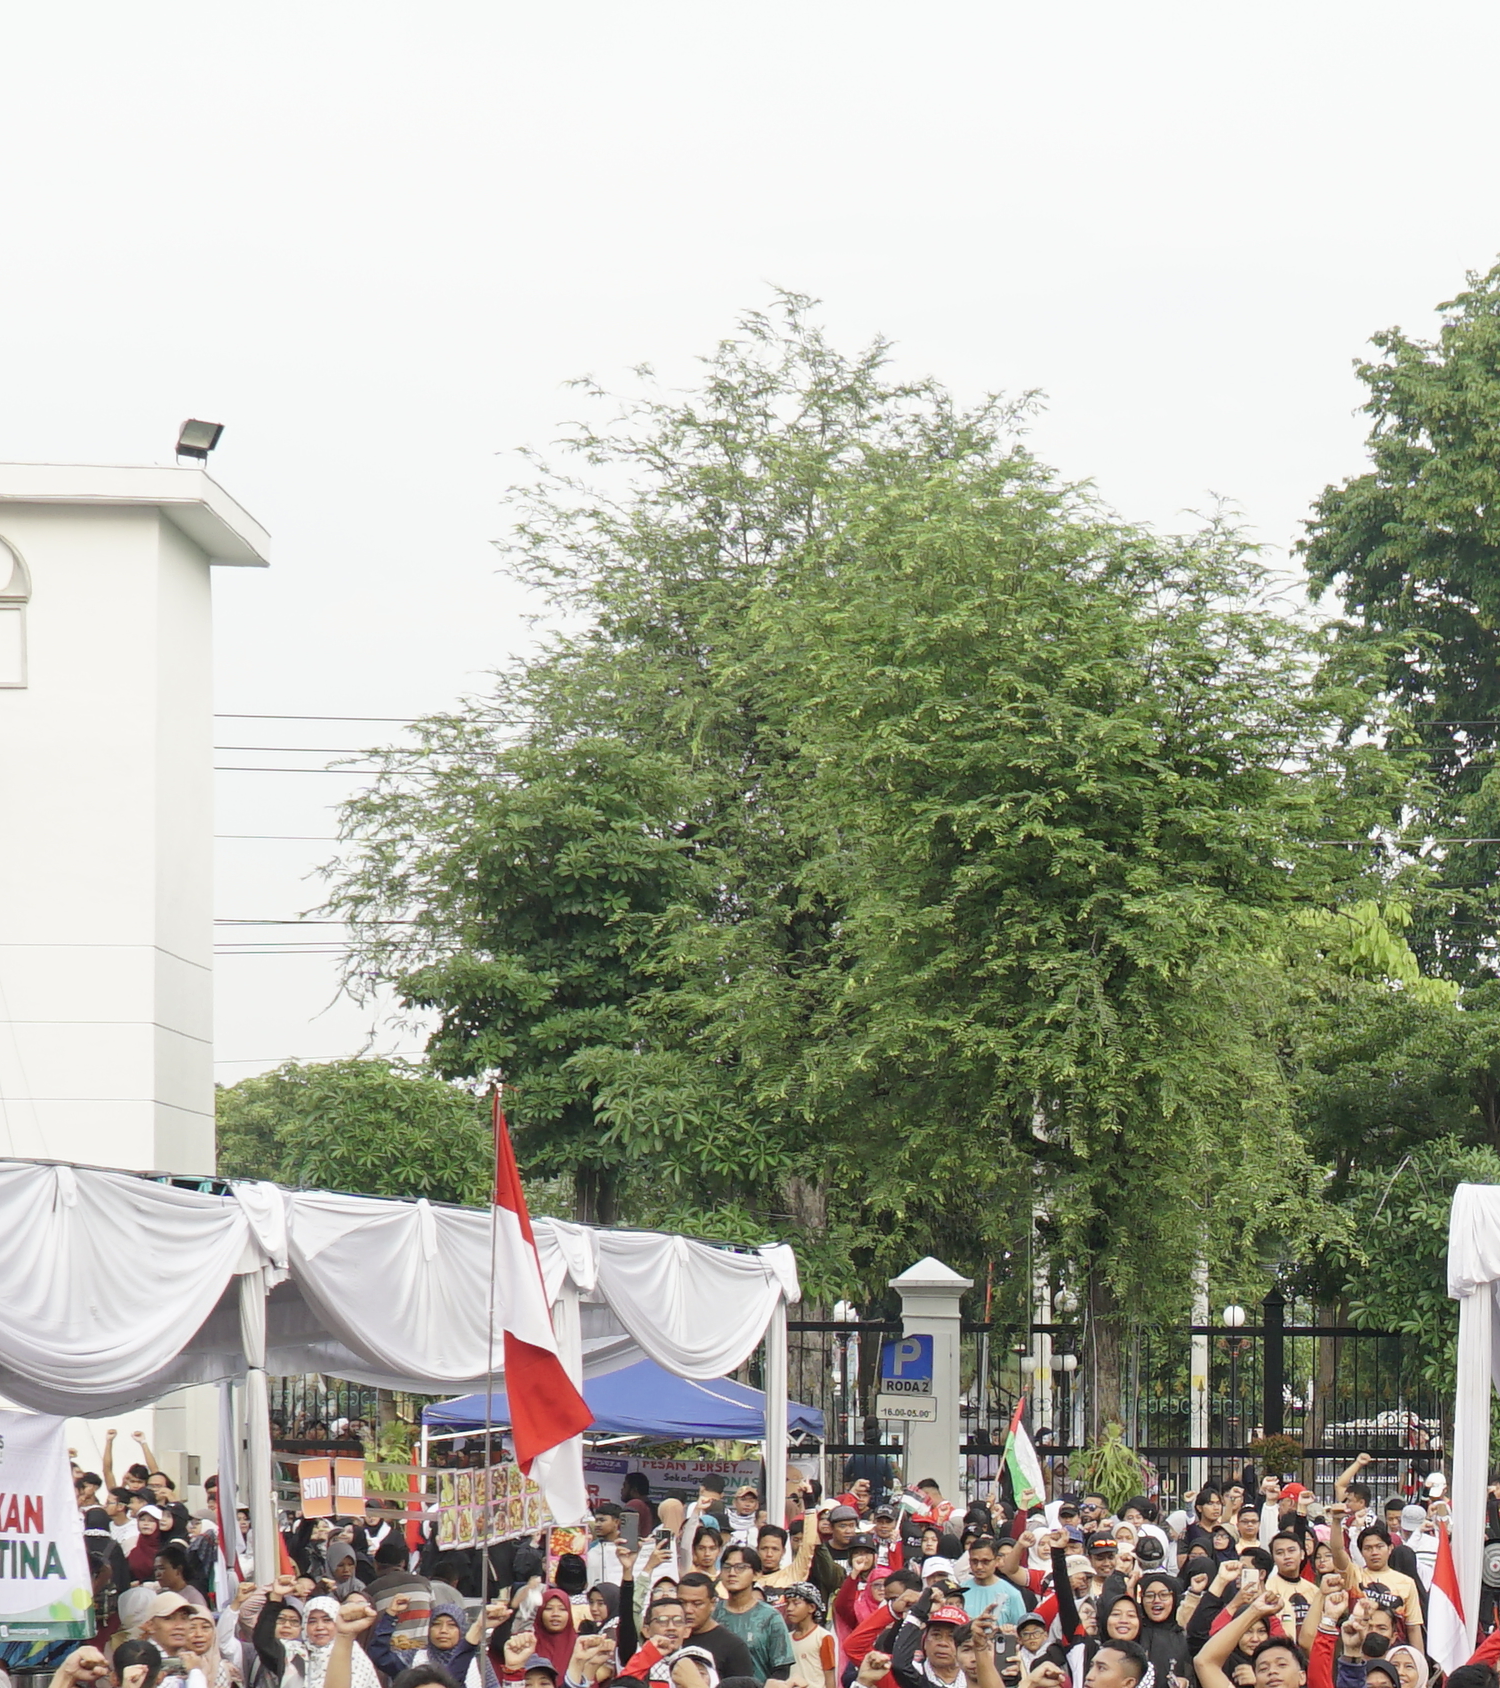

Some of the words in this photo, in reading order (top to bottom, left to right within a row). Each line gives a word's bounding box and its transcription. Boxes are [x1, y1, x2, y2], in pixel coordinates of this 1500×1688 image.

[893, 1338, 921, 1375] P
[886, 1380, 920, 1392] RODA
[922, 1381, 930, 1392] 2
[303, 1476, 328, 1499] SOTO
[338, 1476, 363, 1497] AYAM
